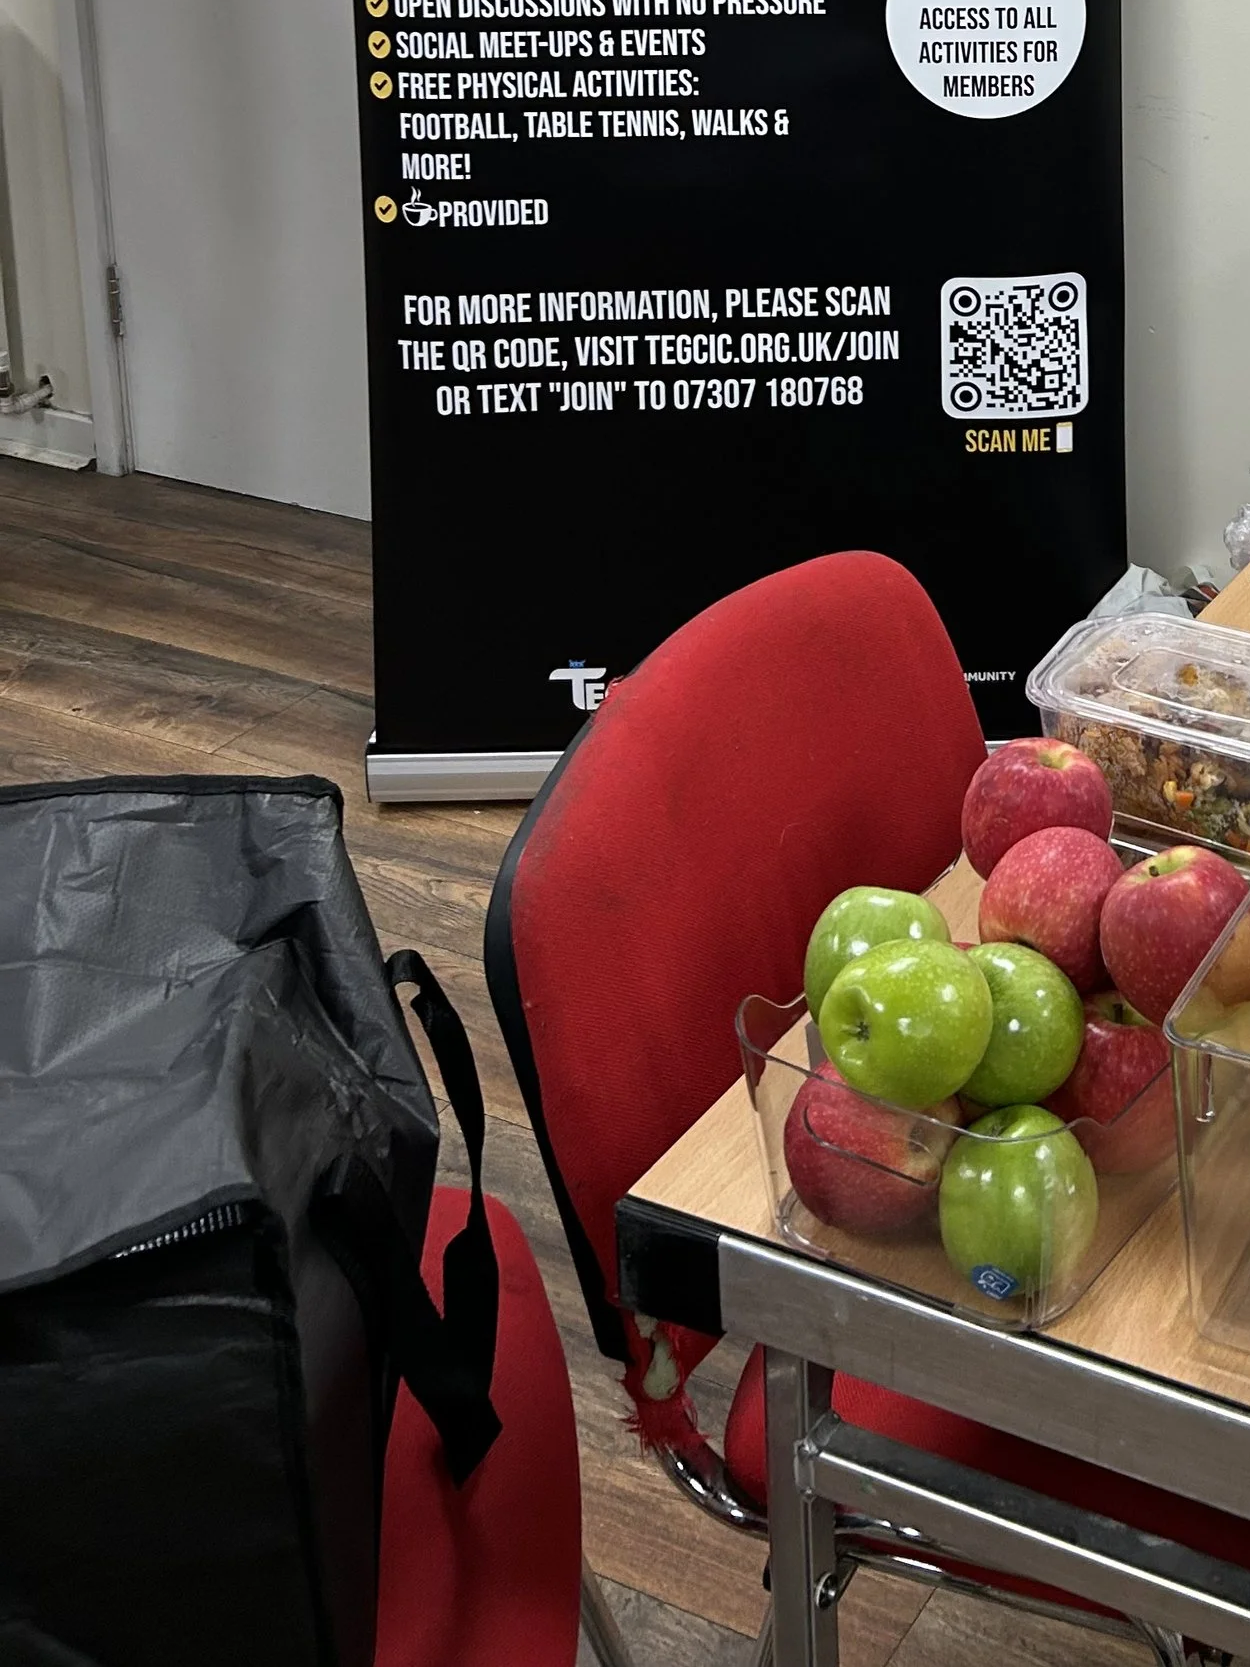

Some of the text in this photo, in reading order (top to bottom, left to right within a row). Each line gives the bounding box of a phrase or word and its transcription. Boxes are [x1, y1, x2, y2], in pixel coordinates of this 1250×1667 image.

[920, 7, 1057, 29] ACCESS TO ALL
[396, 29, 705, 58] SOCIAL MEET-UPS & EVENTS
[919, 41, 1057, 63] ACTIVITIES FOR
[399, 69, 698, 99] FREE PHYSICAL ACTIVITIES:
[944, 75, 1034, 97] MEMBERS
[401, 109, 789, 142] FOOTBALL, TABLE TENNIS, WALKS &
[402, 153, 470, 180] MORE!
[439, 199, 548, 227] PROVIDED
[405, 286, 890, 325] FOR MORE INFORMATION, PLEASE SCAN
[398, 331, 899, 372] THE QR CODE, VISIT TEGCIC.ORG.UK/JOIN
[437, 376, 863, 415] OR TEXT "JOIN" TO 07307 180768
[966, 429, 1050, 452] SCAN ME
[549, 667, 609, 710] TE
